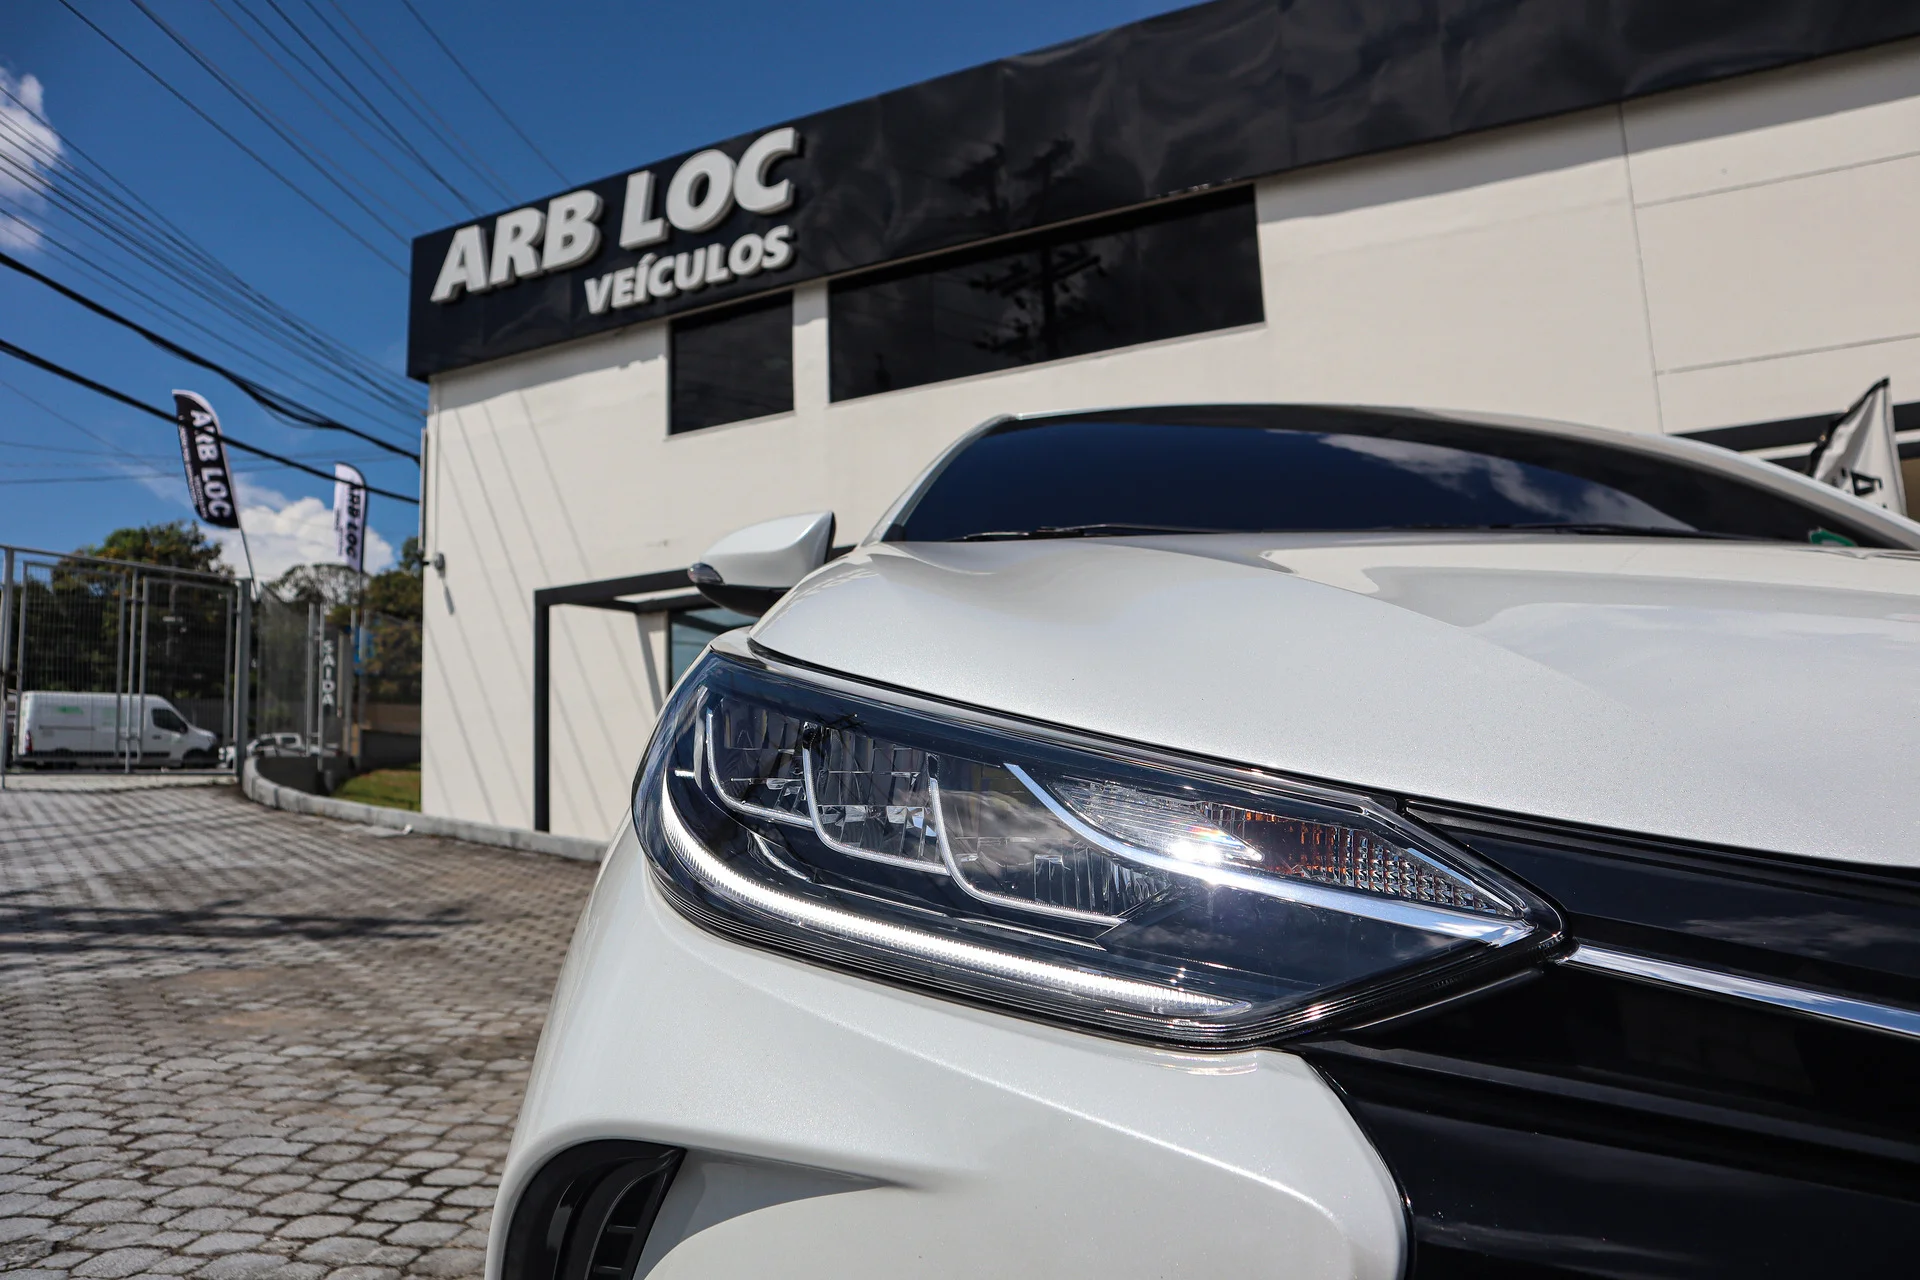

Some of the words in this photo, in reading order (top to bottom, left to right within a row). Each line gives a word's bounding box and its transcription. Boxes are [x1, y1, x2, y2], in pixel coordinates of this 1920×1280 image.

[431, 190, 603, 304] ARB
[619, 127, 799, 250] LOC
[584, 225, 795, 314] VEÍCULOS
[201, 467, 232, 517] LOC
[346, 522, 359, 559] LOC
